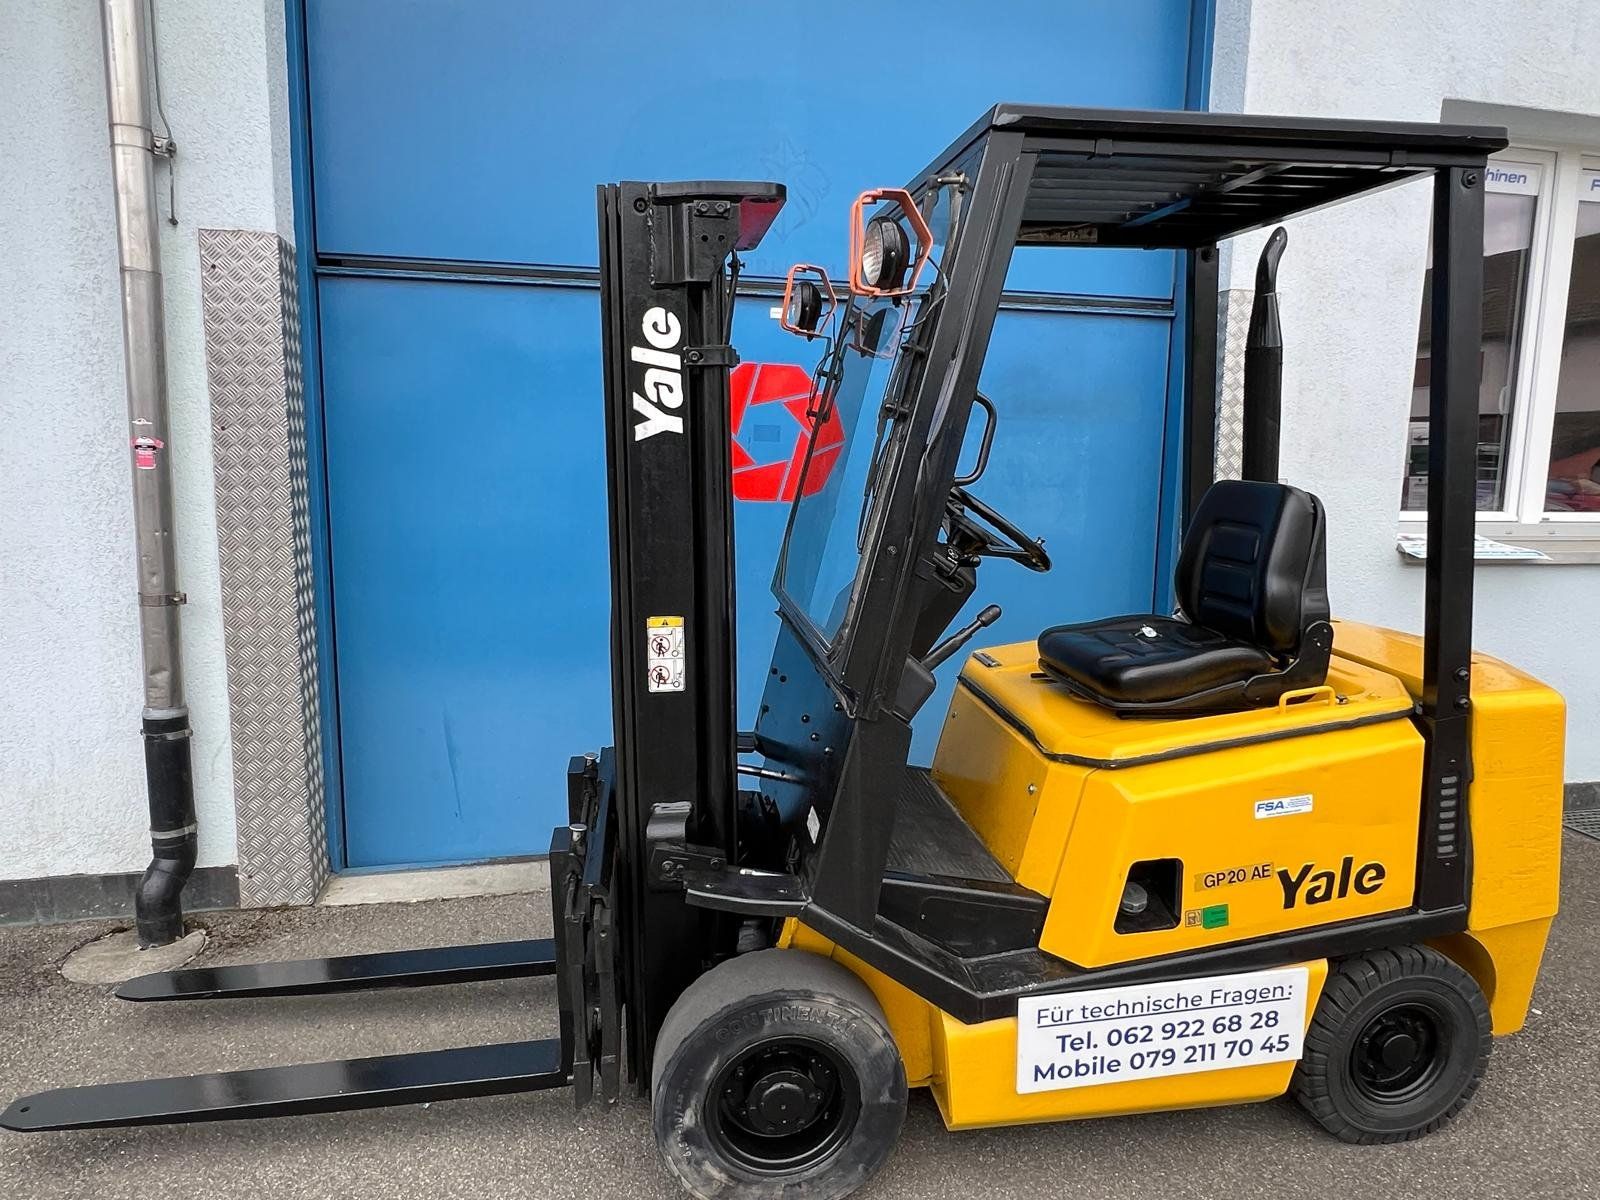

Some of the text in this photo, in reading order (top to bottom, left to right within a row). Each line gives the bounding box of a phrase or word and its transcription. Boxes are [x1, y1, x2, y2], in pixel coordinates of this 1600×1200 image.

[1484, 167, 1528, 185] hinen
[631, 307, 684, 441] Yale
[1256, 800, 1285, 813] FSA
[1204, 864, 1271, 889] GP20 AE
[1277, 856, 1386, 909] Yale
[714, 1004, 857, 1042] CONTINENTAL
[1037, 985, 1293, 1025] Für technische Fragen:
[1055, 1010, 1279, 1053] Tel. 062 922 68 28
[1033, 1033, 1290, 1083] Mobile 079 211 70 45
